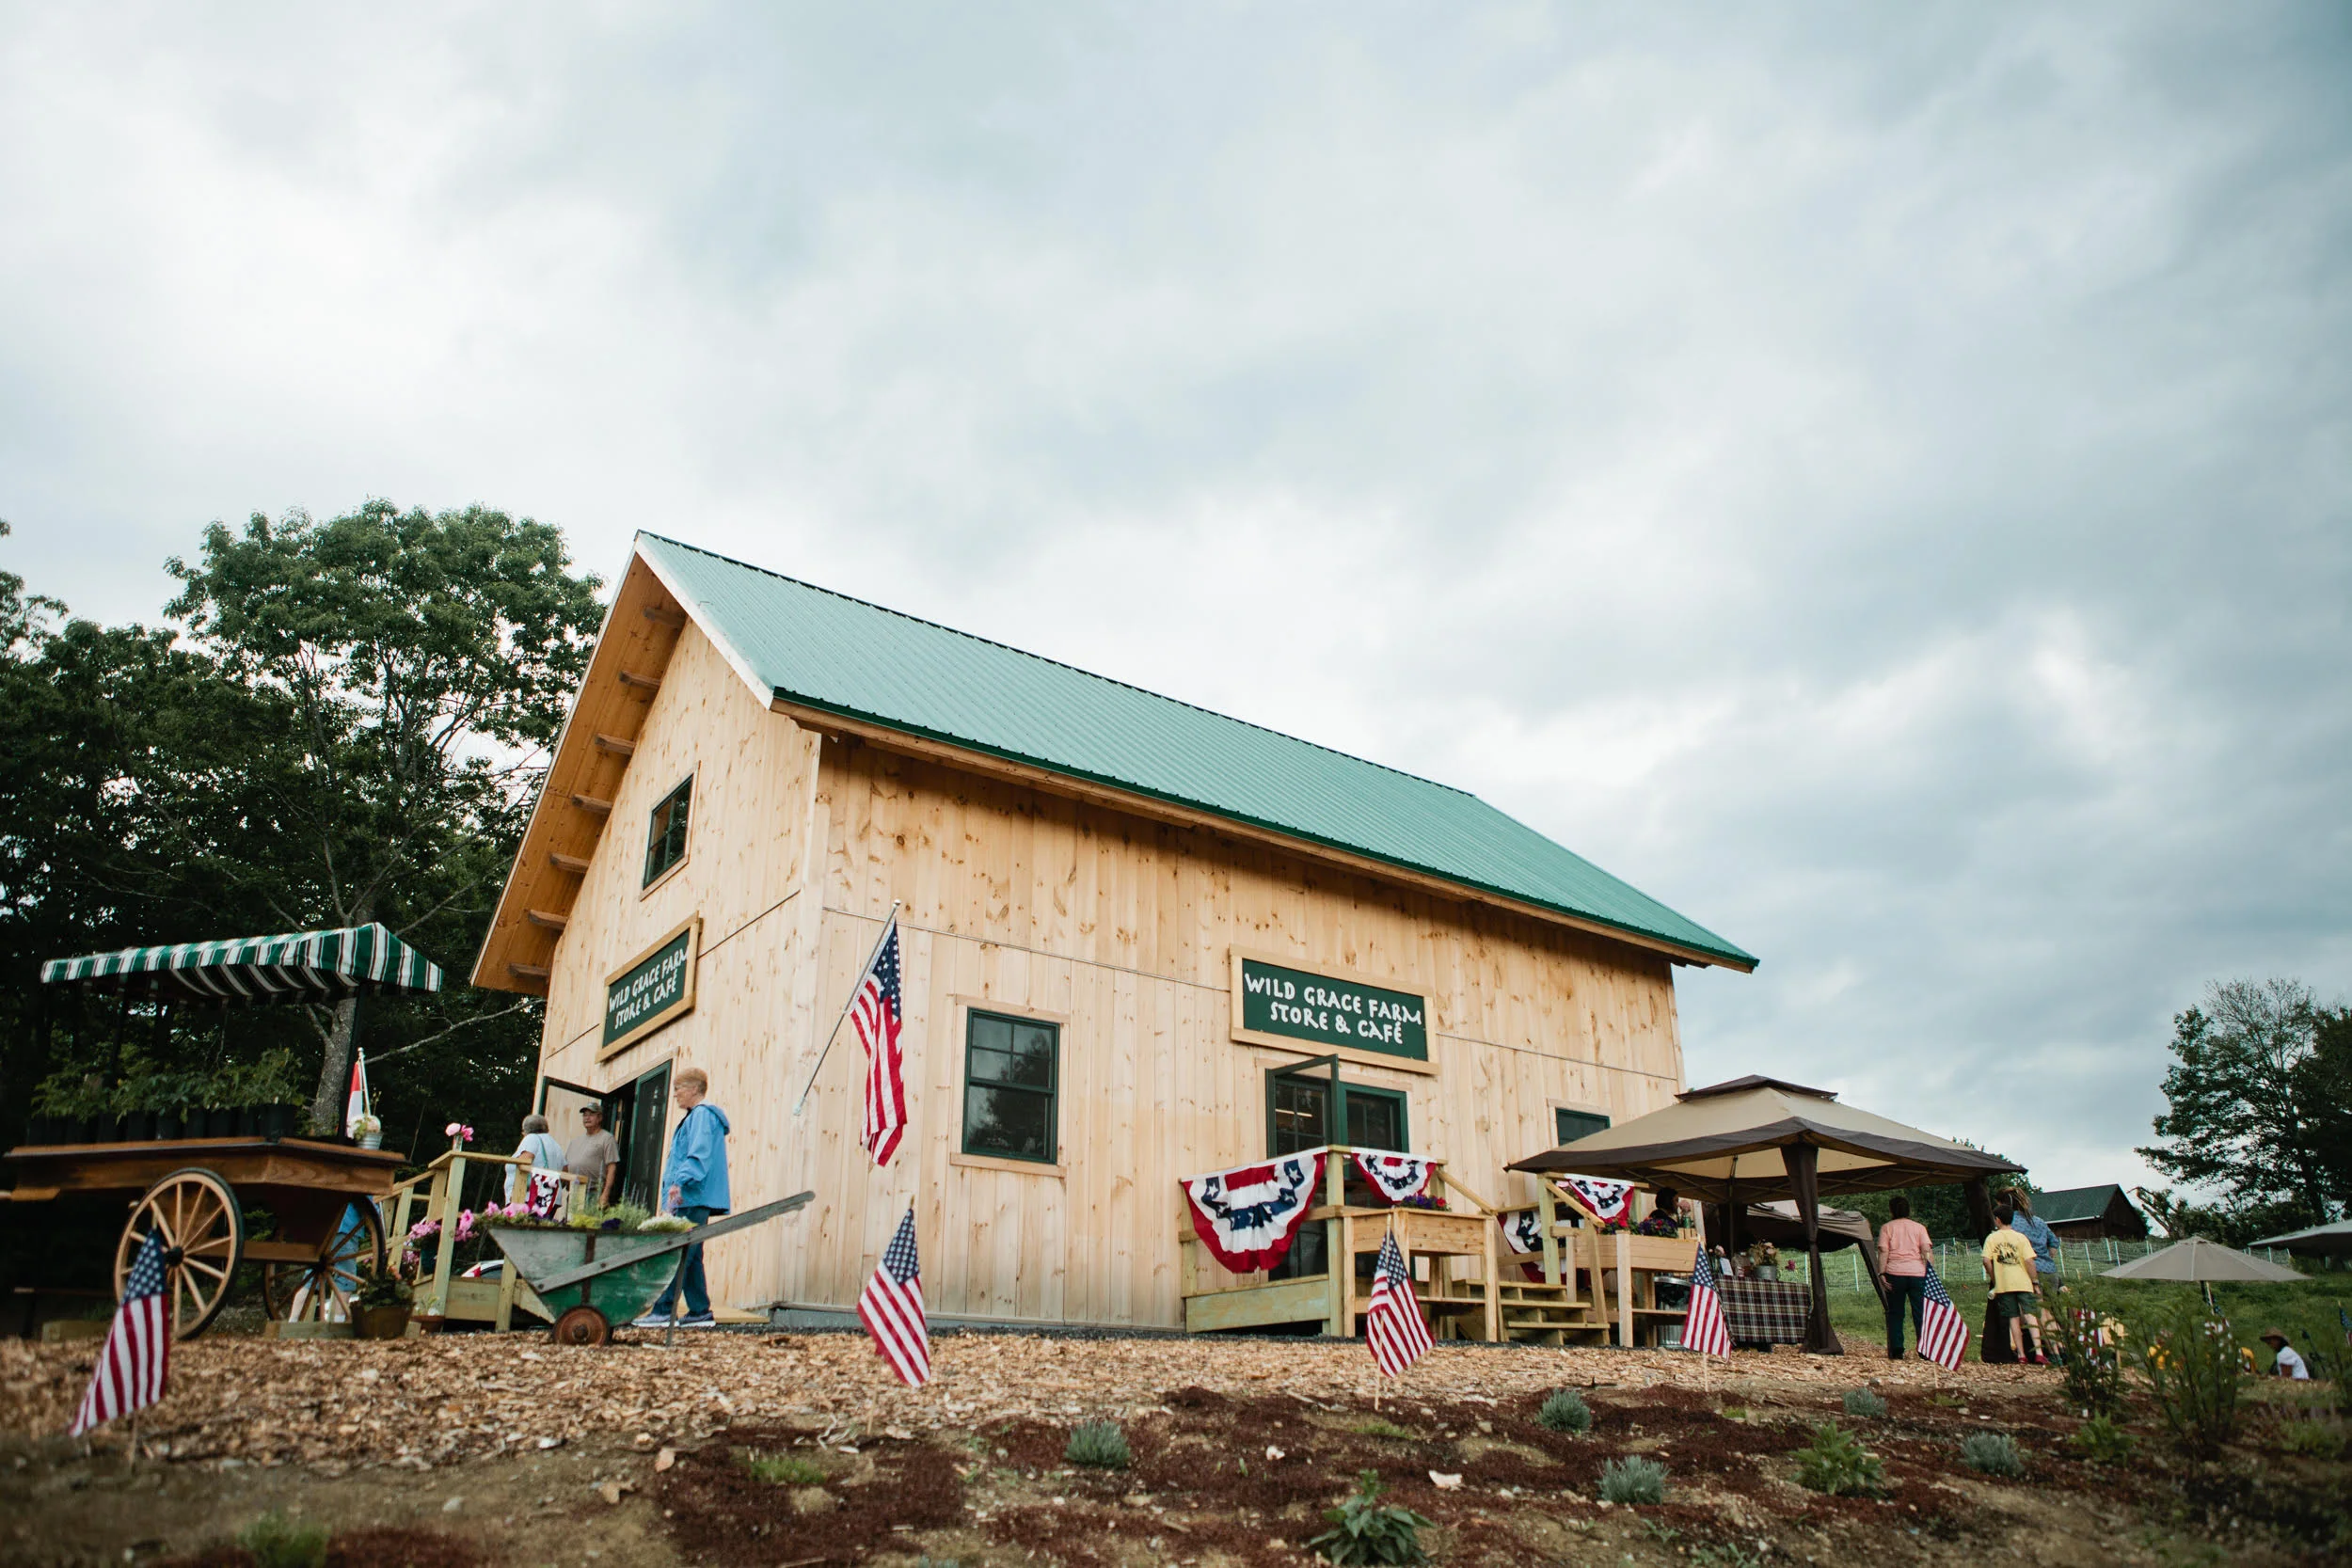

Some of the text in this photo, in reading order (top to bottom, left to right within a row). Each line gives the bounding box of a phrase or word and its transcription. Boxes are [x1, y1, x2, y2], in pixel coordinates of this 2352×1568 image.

[609, 986, 630, 1013] WILD
[632, 964, 660, 998] GRACE
[614, 969, 677, 1030] STORE & CAFÉ
[1245, 974, 1422, 1025] WILD GRACE FARM
[1271, 1002, 1403, 1044] STORE & CAFÉ
